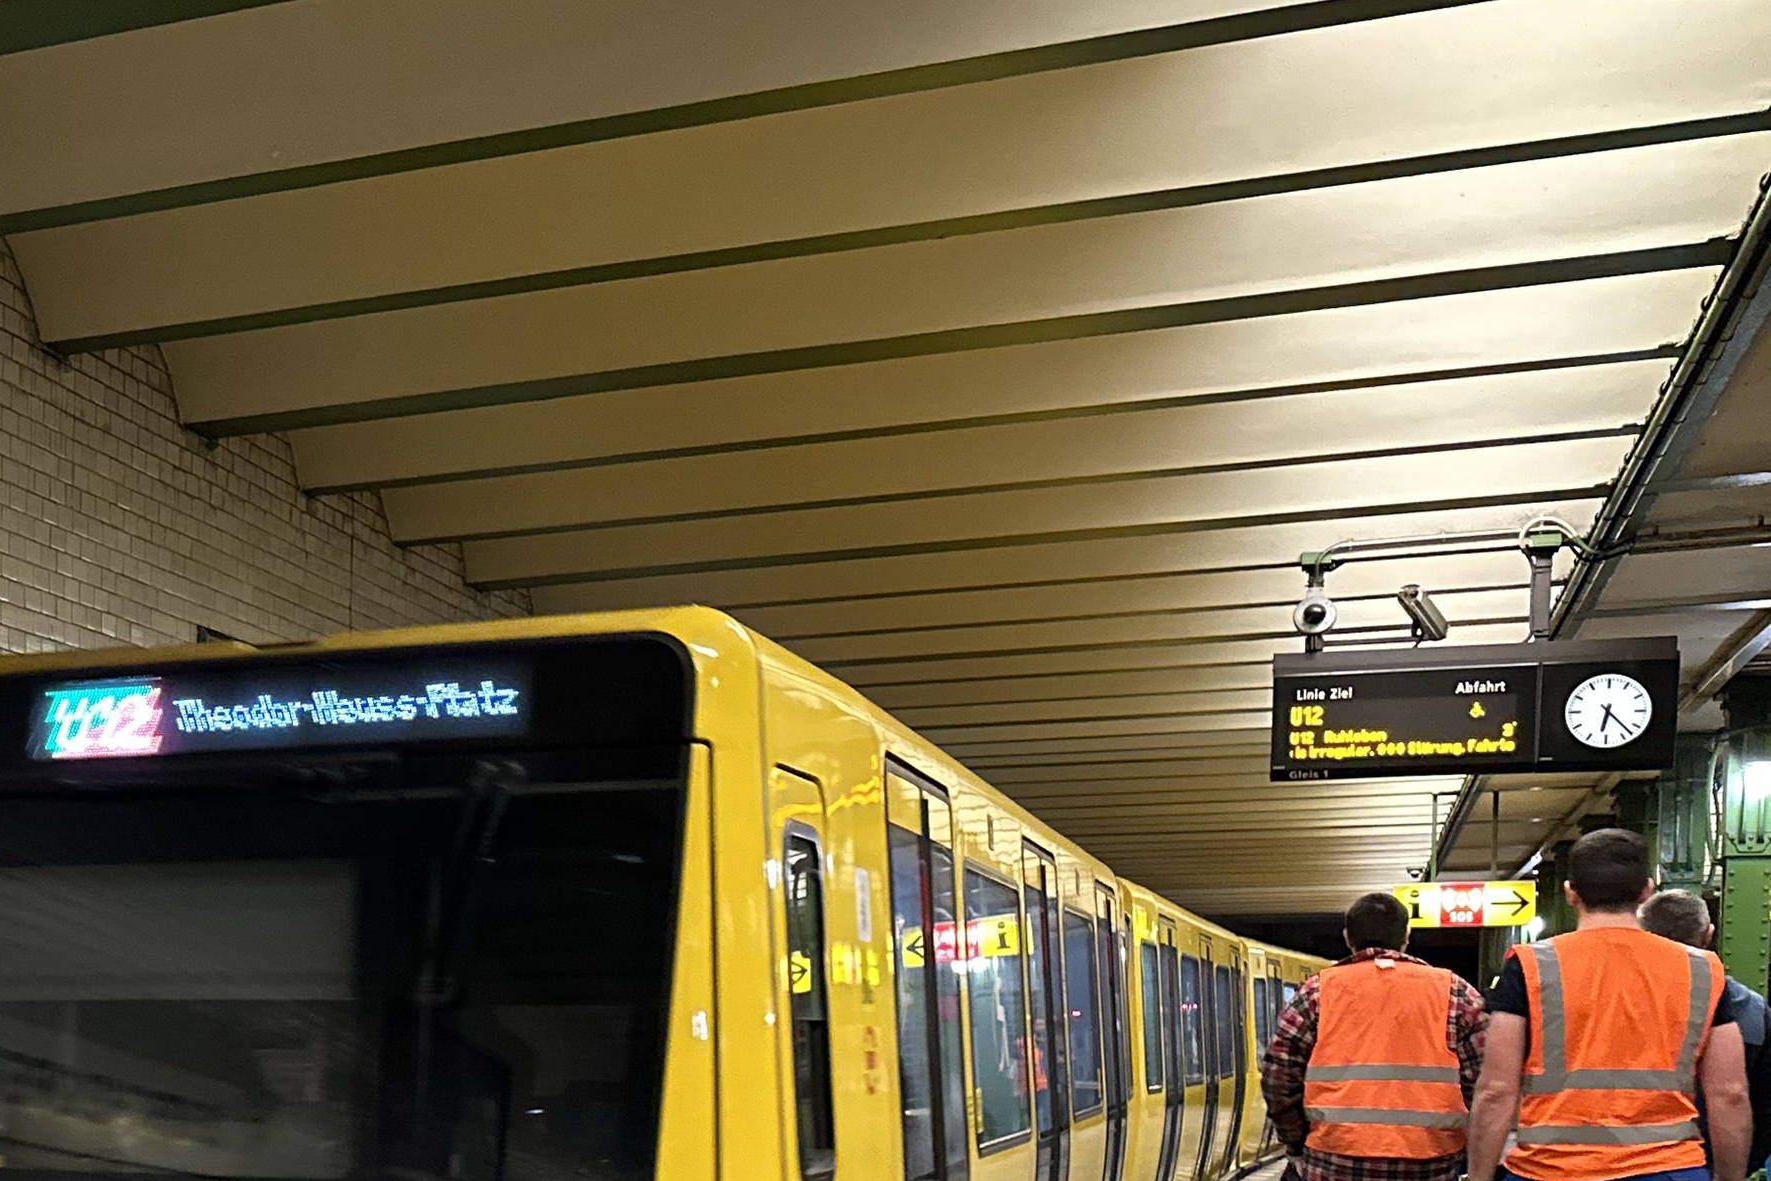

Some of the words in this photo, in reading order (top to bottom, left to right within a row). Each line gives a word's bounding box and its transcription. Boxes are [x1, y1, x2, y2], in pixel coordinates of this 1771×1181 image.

[1296, 688, 1326, 701] Linie
[1329, 686, 1354, 700] Ziel
[1454, 680, 1507, 695] Abfahrt
[1290, 705, 1324, 727] U12
[1289, 731, 1315, 746] U12
[1288, 769, 1320, 779] Gleis
[1323, 769, 1329, 779] 1
[1449, 910, 1474, 923] SOS
